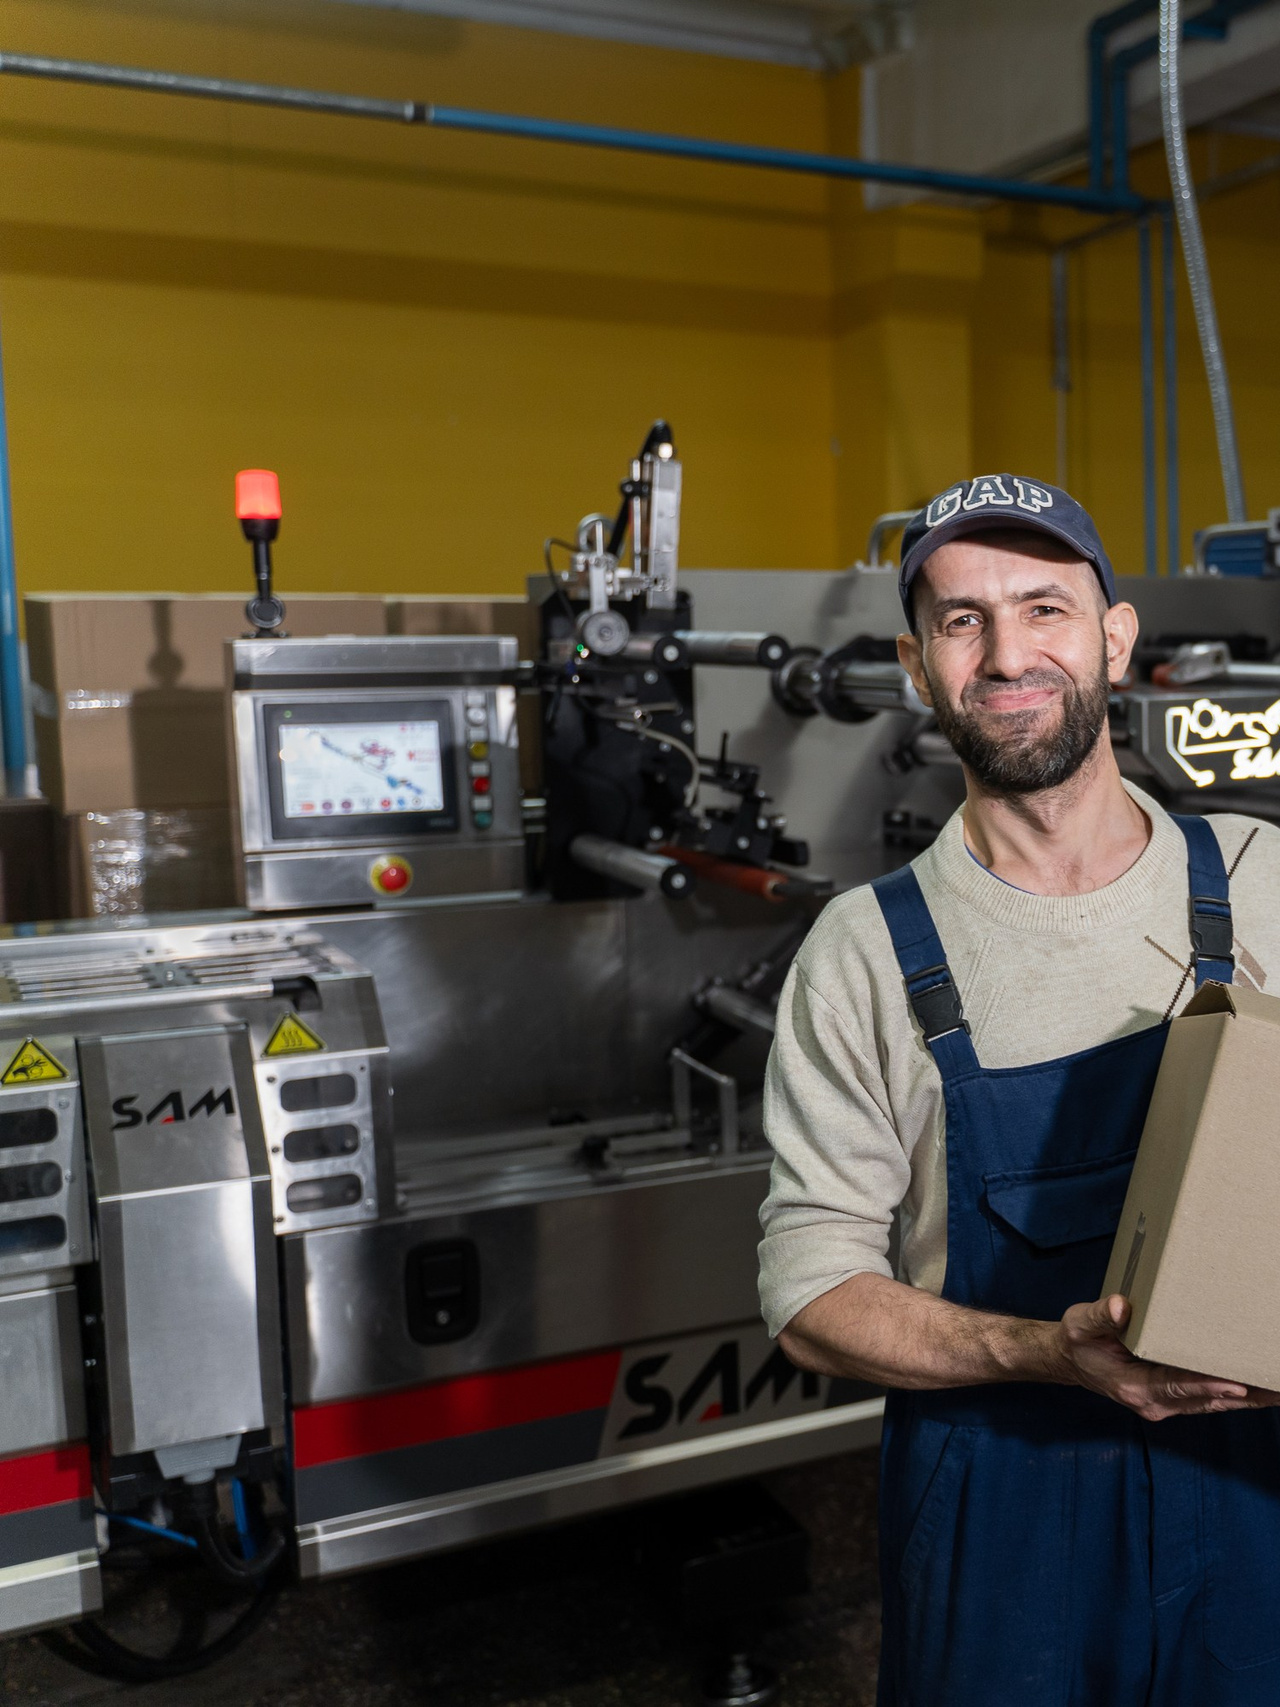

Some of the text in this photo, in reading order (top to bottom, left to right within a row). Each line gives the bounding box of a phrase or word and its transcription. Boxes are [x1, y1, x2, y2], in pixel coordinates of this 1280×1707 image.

[926, 475, 1053, 527] GAP
[111, 1087, 236, 1131] SAM
[617, 1340, 821, 1442] SAM
